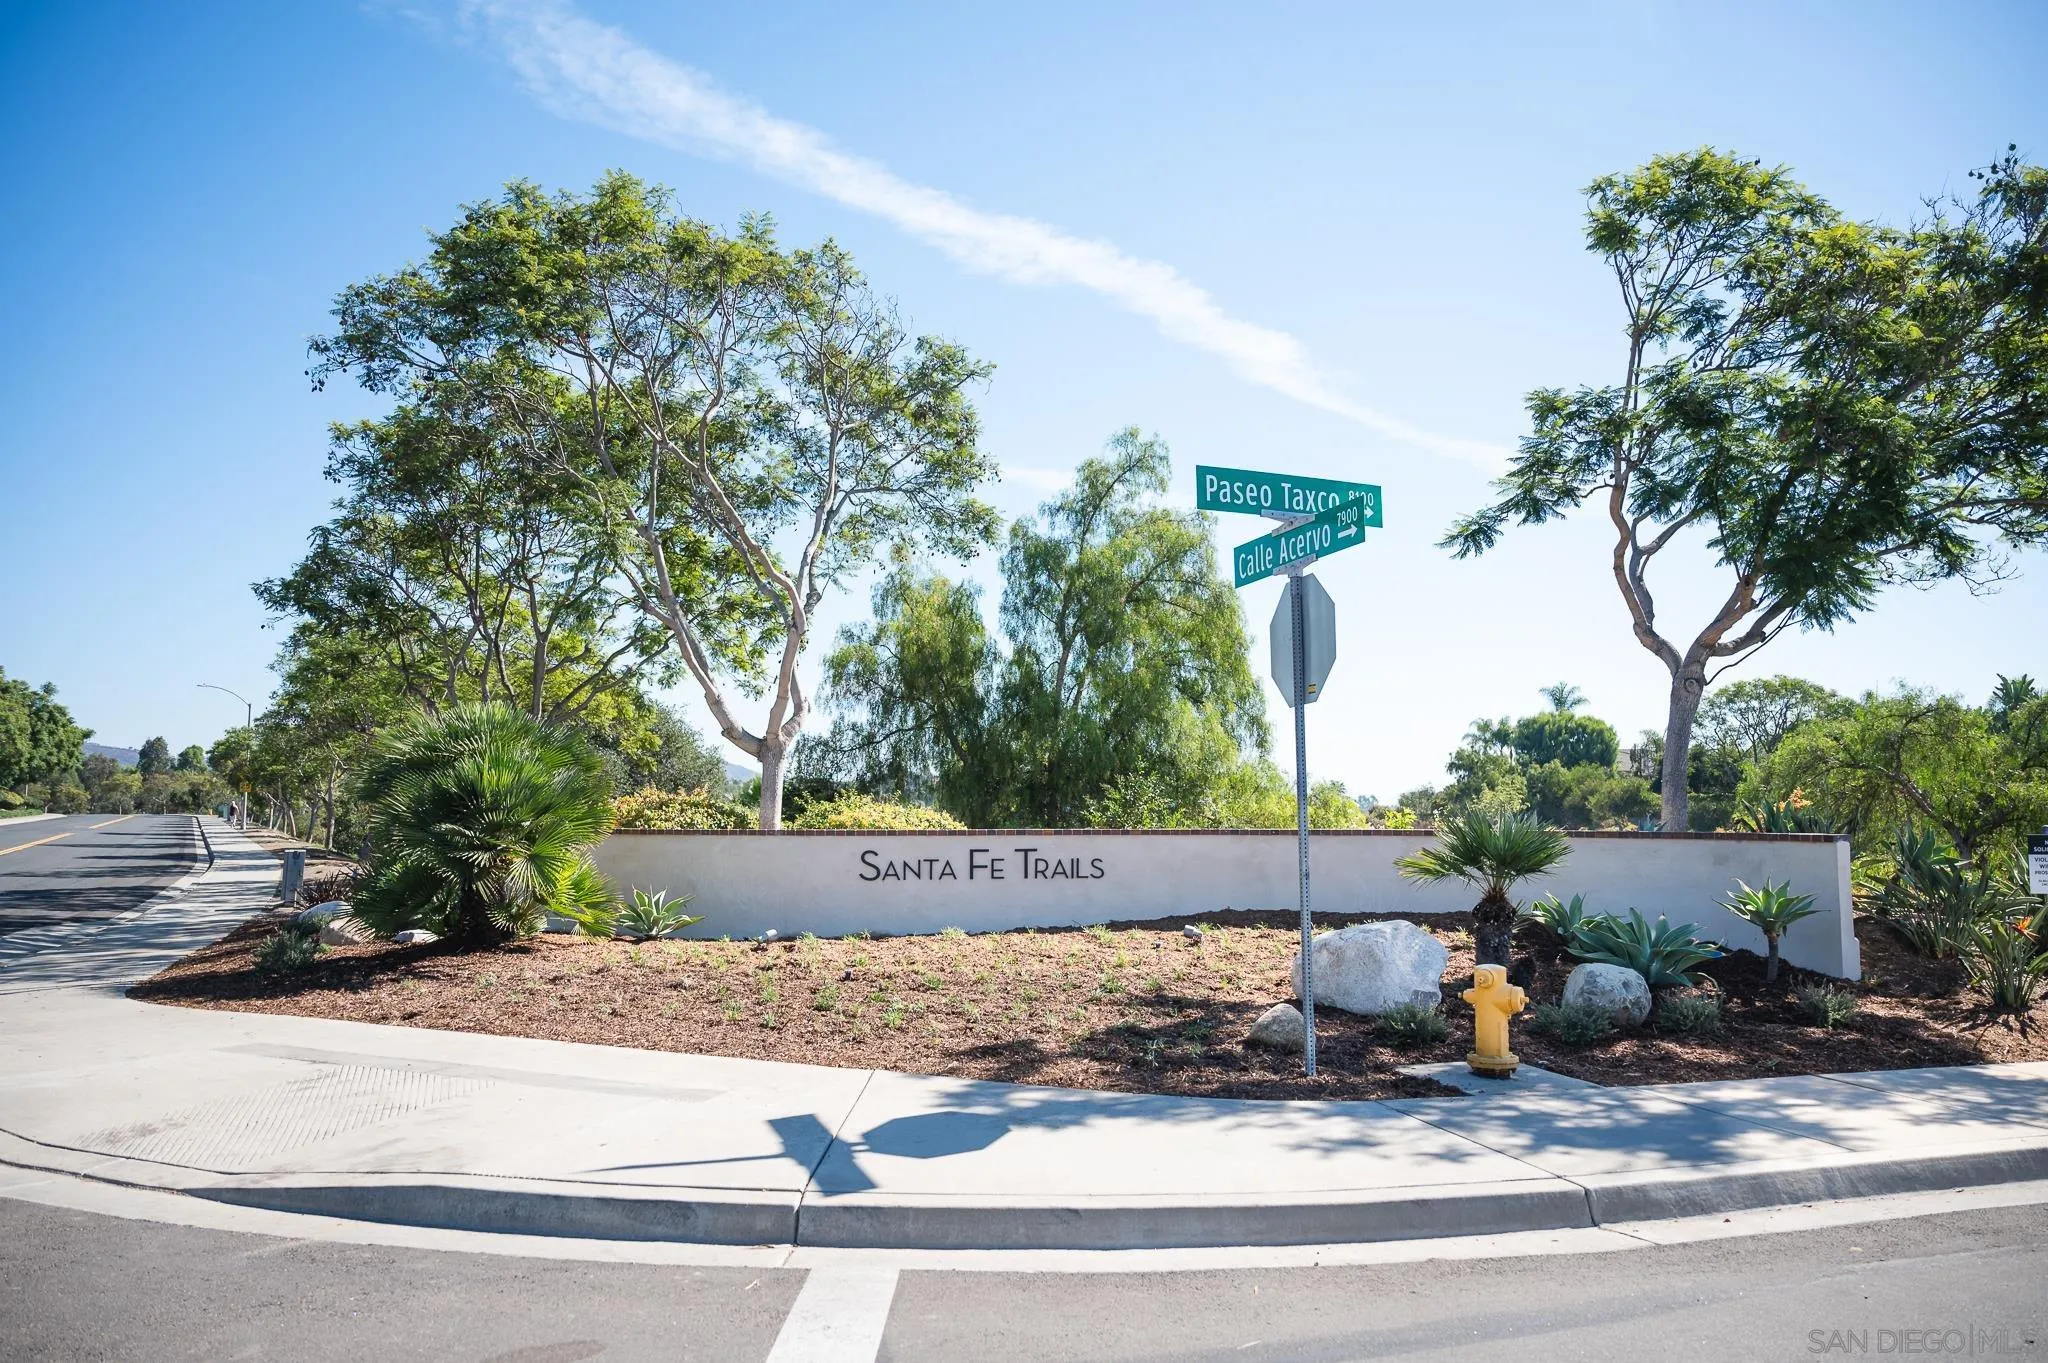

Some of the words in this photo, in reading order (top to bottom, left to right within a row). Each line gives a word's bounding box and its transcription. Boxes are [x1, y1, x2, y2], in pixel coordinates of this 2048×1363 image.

[1205, 474, 1272, 507] Paseo
[1281, 483, 1340, 512] Taxco
[1337, 506, 1358, 527] 7900
[1239, 545, 1273, 579] Calle
[1279, 525, 1331, 564] Acervo
[859, 849, 957, 881] SANTA
[969, 848, 1004, 880] FE
[1014, 848, 1105, 880] TRAILS
